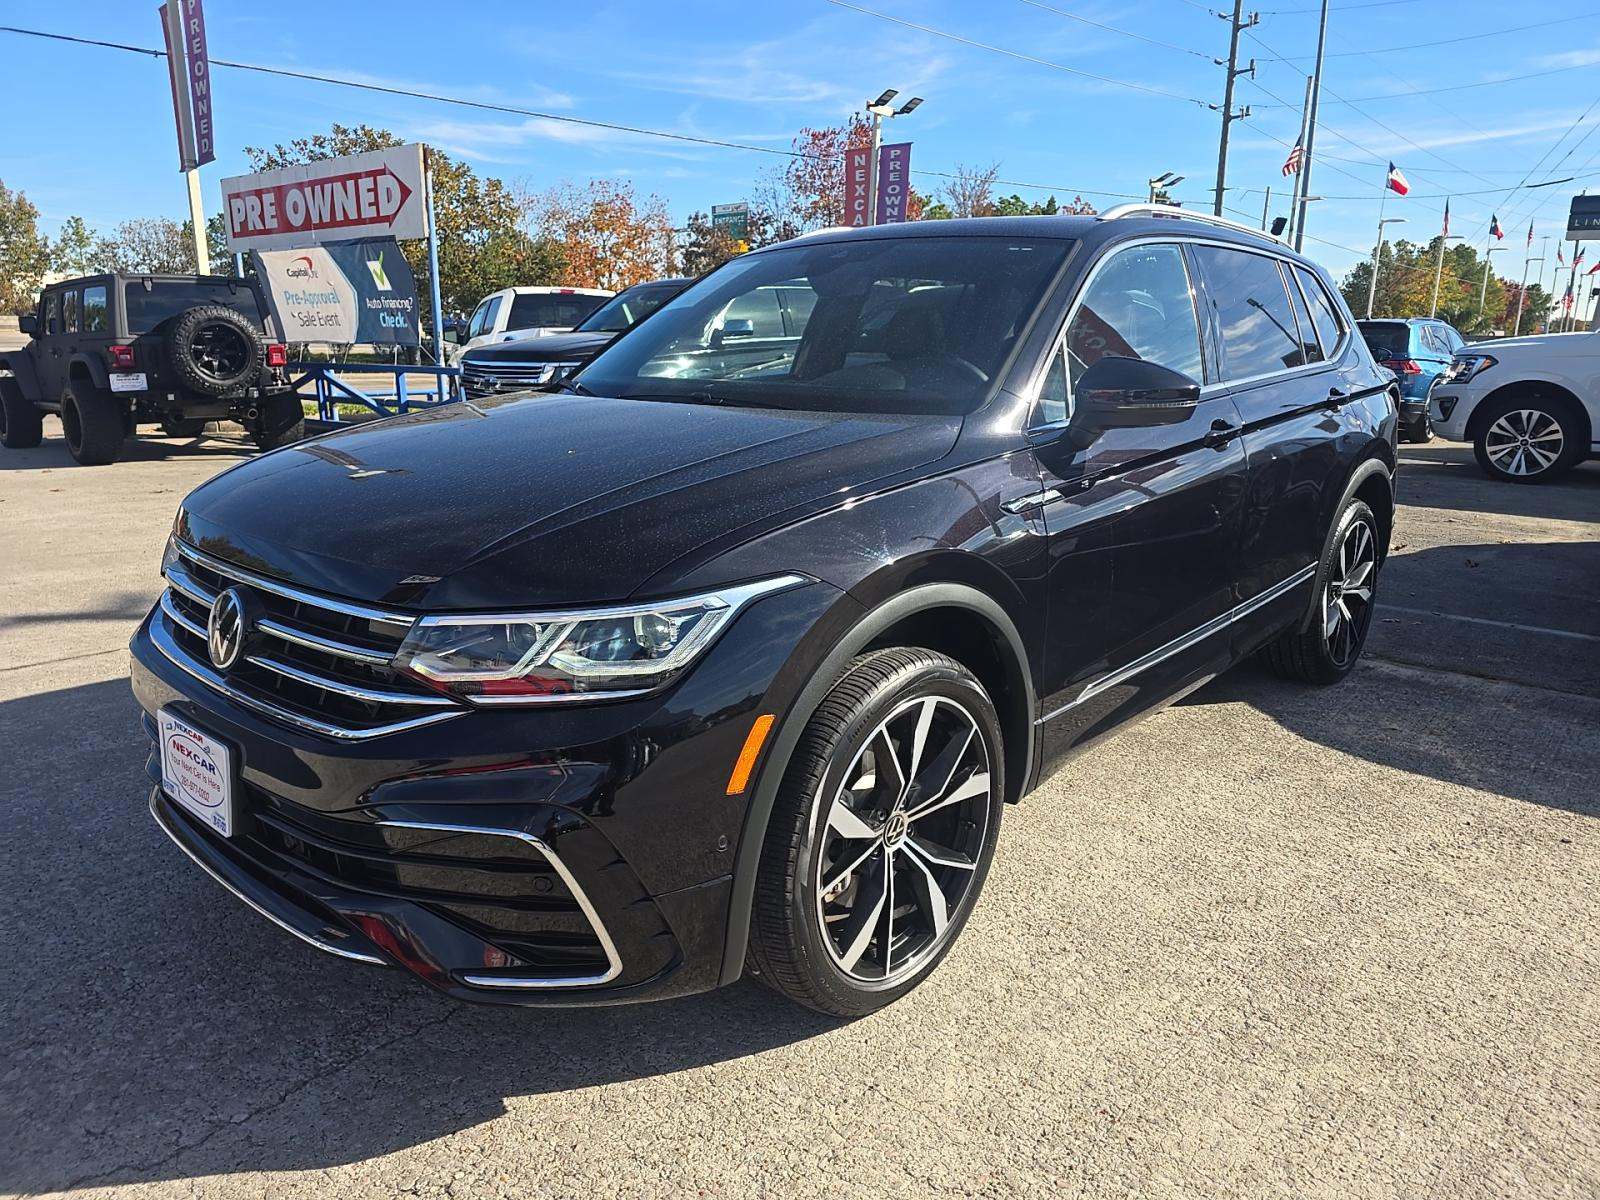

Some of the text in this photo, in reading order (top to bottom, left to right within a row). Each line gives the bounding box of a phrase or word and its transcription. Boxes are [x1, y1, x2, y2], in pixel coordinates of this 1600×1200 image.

[853, 154, 866, 225] NEXCA
[230, 174, 402, 232] PRE OWNED
[1574, 218, 1600, 227] LIN
[286, 267, 308, 279] Capital
[284, 288, 340, 308] Pre-Approval
[366, 297, 382, 309] Auto
[297, 312, 342, 327] Sale Event
[379, 311, 408, 328] Check.
[175, 721, 204, 744] NEXCAR
[172, 740, 216, 775] NEXCAR
